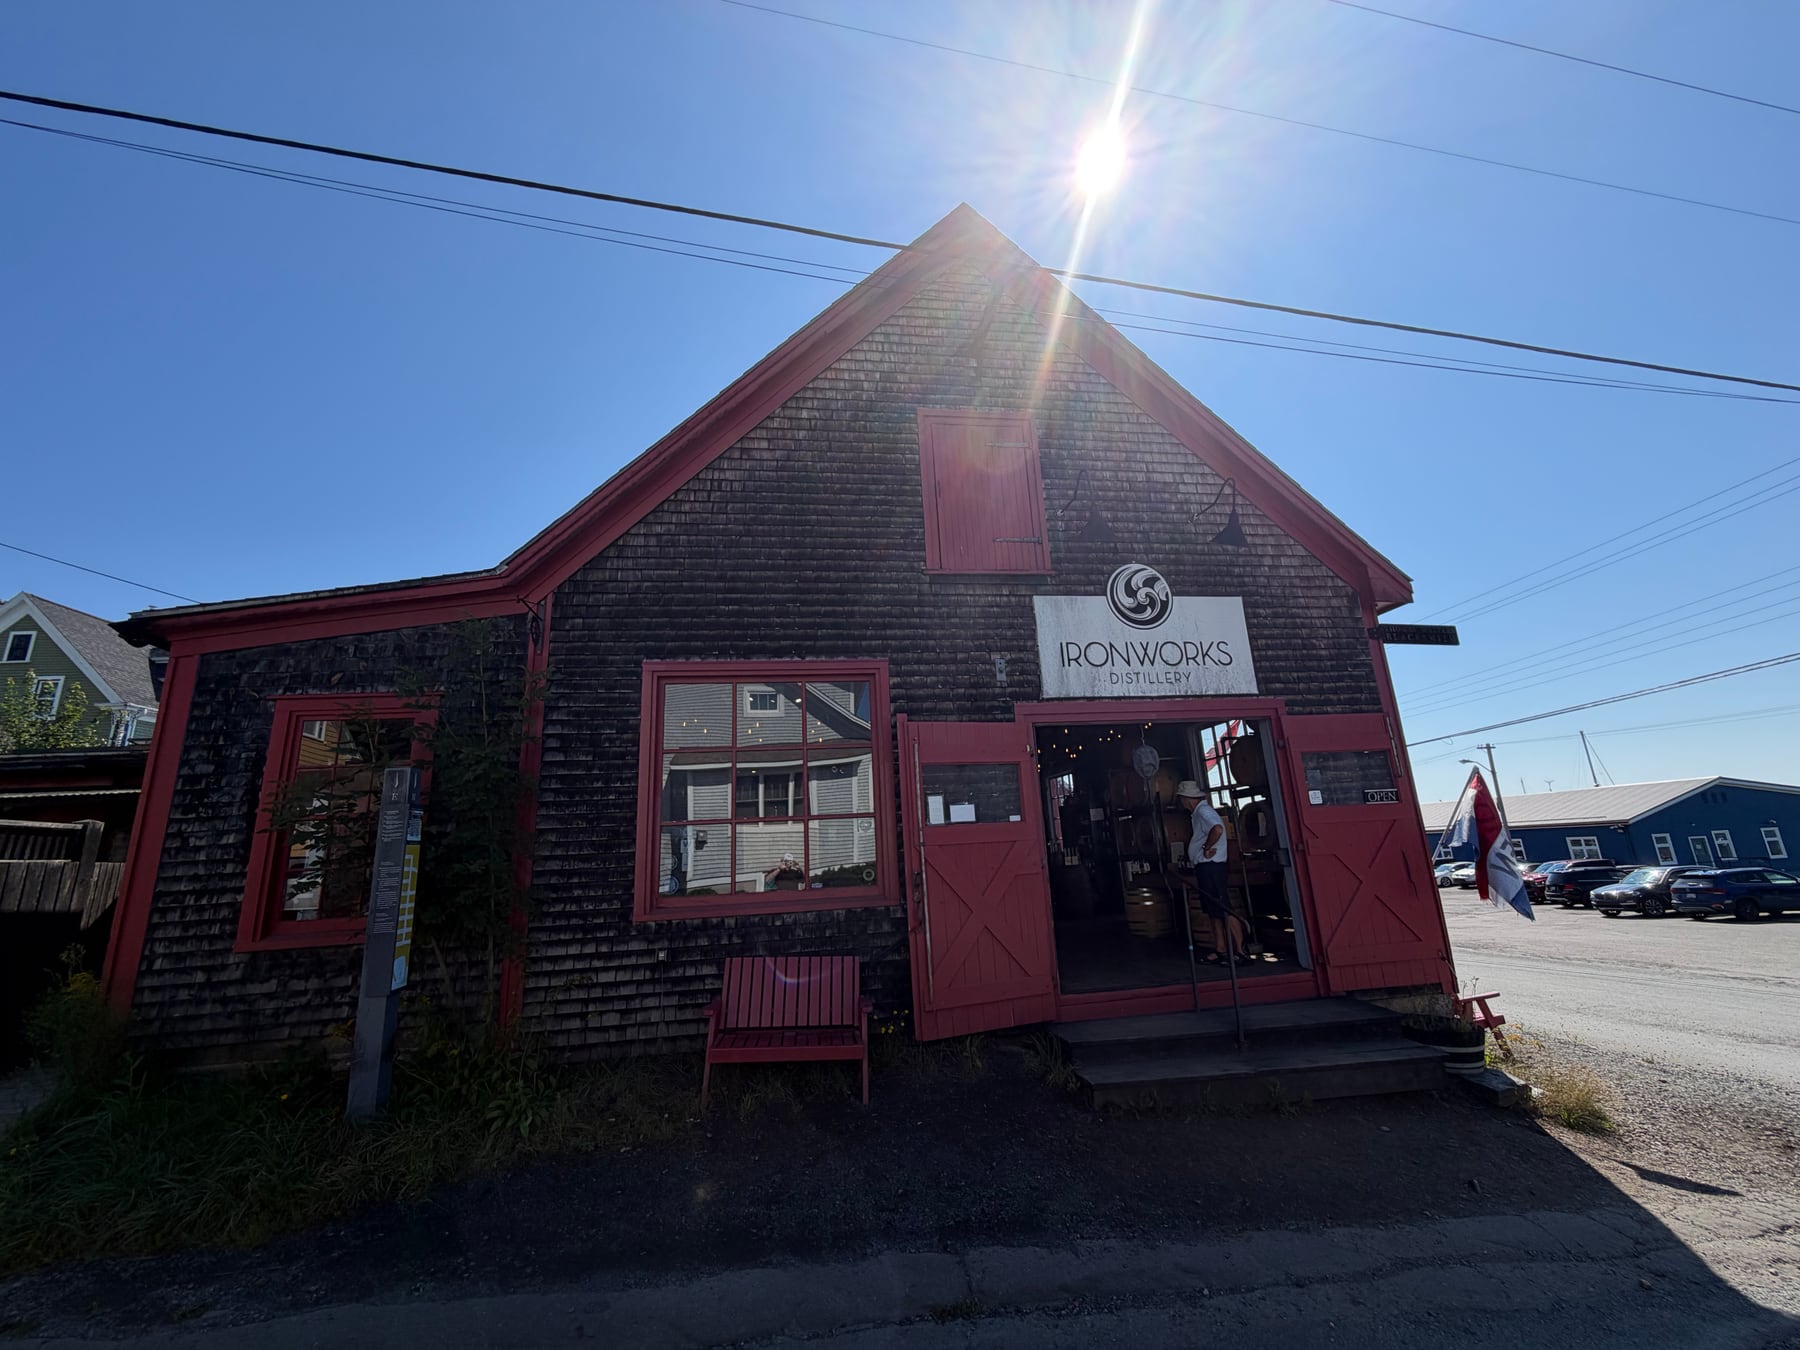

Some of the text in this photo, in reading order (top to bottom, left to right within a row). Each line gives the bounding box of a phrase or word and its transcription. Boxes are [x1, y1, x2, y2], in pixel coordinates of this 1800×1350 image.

[1059, 641, 1233, 668] IRONWORKS
[1109, 671, 1192, 685] DISTILLERY
[1367, 791, 1396, 802] OPEN
